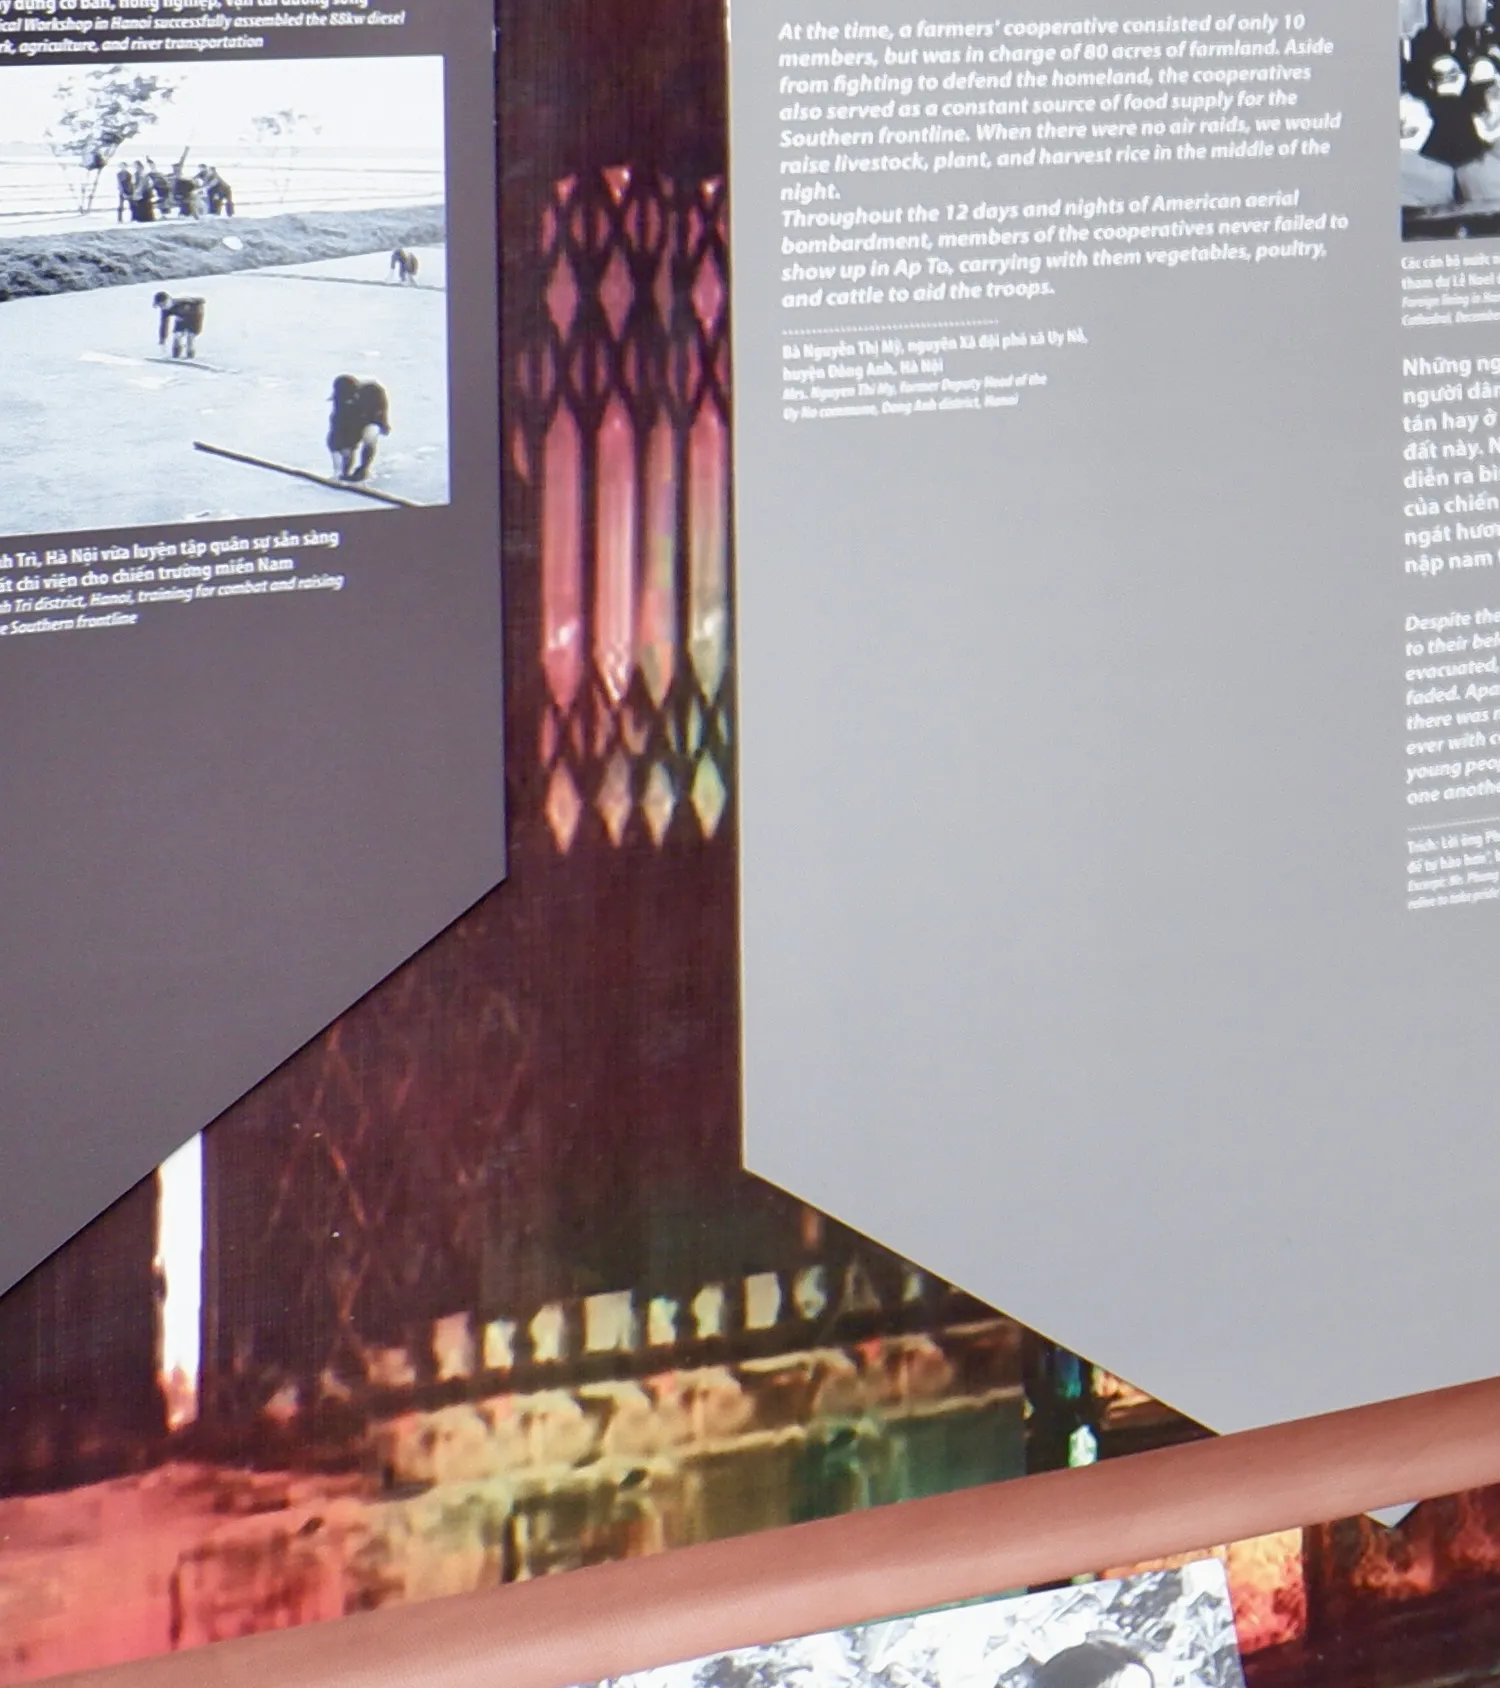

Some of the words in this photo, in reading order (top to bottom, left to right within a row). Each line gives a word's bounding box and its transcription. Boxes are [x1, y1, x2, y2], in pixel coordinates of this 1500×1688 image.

[93, 16, 109, 29] in
[306, 11, 327, 26] the
[777, 22, 802, 40] At
[806, 21, 839, 40] the
[843, 20, 894, 40] time,
[898, 23, 912, 38] a
[1003, 16, 1118, 39] cooperative
[1122, 14, 1211, 33] consisted
[1214, 13, 1236, 31] of
[1237, 13, 1278, 34] only
[1284, 13, 1305, 29] 10
[101, 36, 130, 51] and
[778, 47, 878, 67] members,
[883, 45, 918, 65] but
[922, 49, 960, 63] was
[965, 44, 983, 62] in
[988, 44, 1056, 65] charge
[1059, 42, 1082, 60] of
[1083, 43, 1108, 60] 80
[1111, 45, 1161, 59] acres
[1165, 40, 1186, 57] of
[1189, 38, 1280, 57] farmland.
[1283, 37, 1333, 54] Aside
[778, 127, 873, 147] Southern
[878, 124, 970, 144] frontline.
[976, 122, 1031, 141] When
[1036, 120, 1087, 139] there
[1091, 123, 1137, 137] were
[1141, 122, 1165, 135] no
[1169, 116, 1195, 134] air
[1199, 115, 1250, 133] raids,
[1255, 118, 1280, 131] we
[1285, 112, 1341, 130] would
[15, 575, 39, 591] chi
[80, 570, 109, 586] cho
[257, 557, 293, 571] Nam
[1404, 611, 1472, 632] Despite
